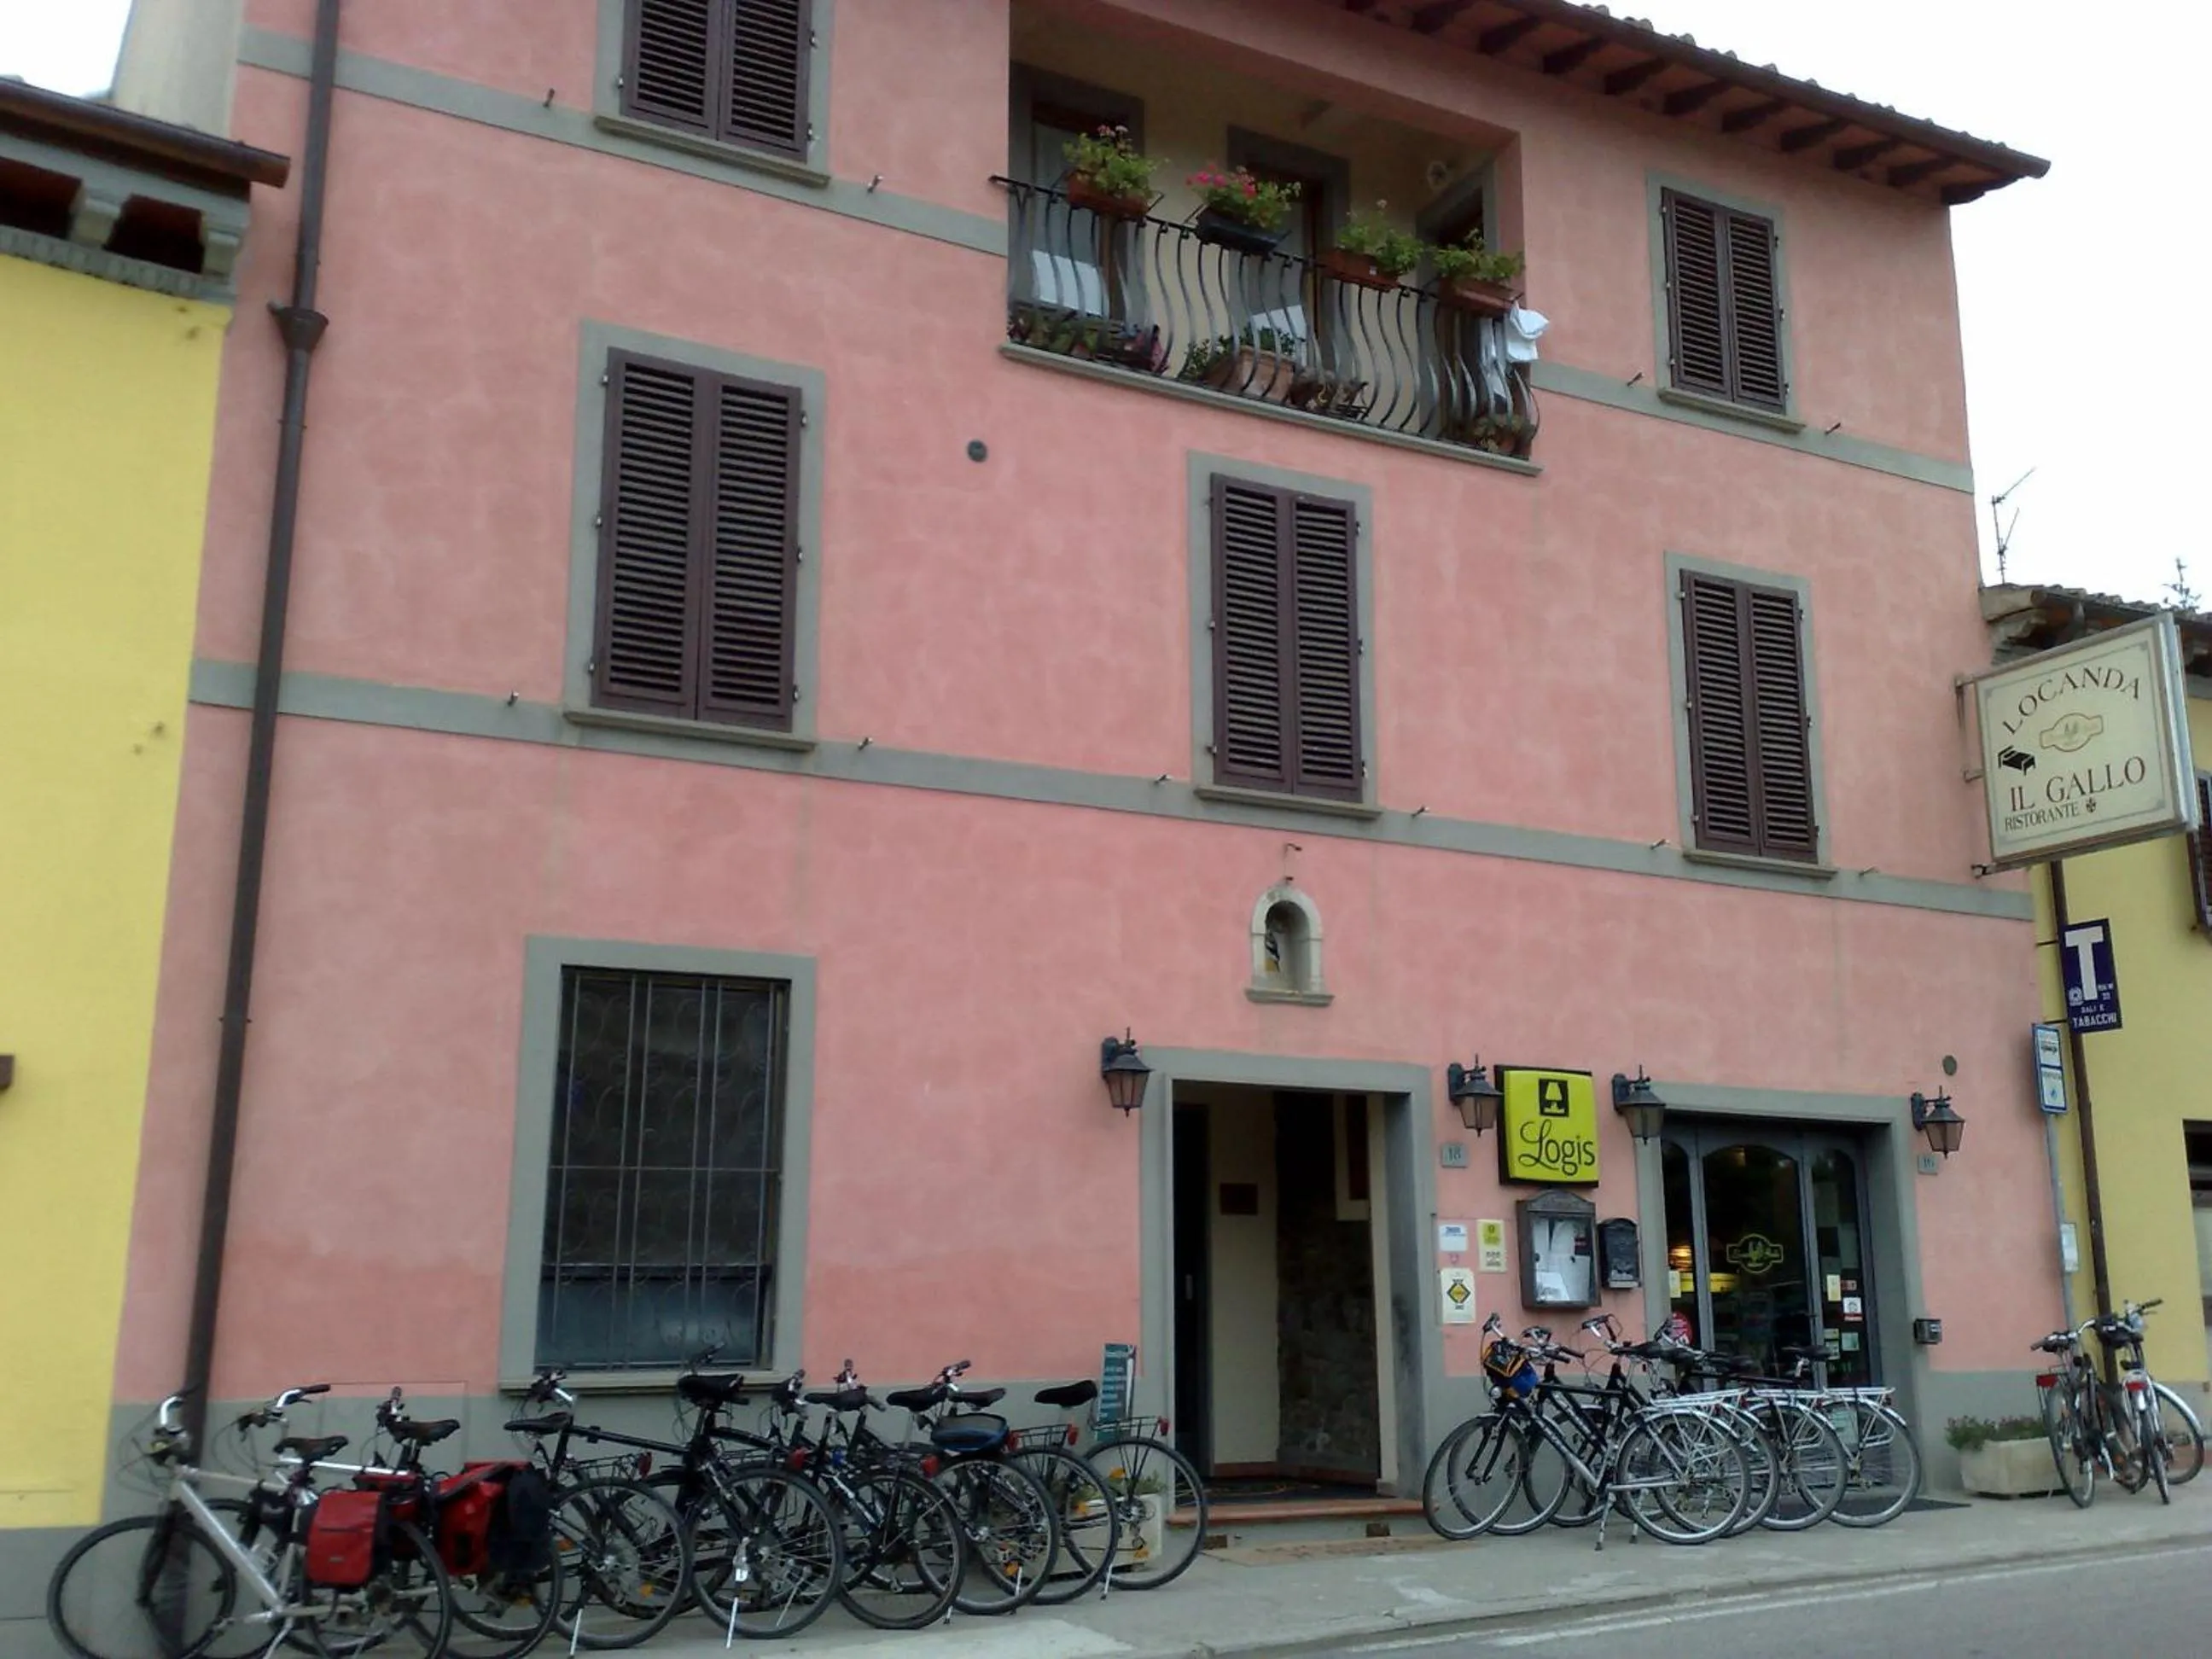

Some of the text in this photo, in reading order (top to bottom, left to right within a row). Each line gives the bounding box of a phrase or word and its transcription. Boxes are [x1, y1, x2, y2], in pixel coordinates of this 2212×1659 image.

[2003, 667, 2139, 735] LOCANDA
[2011, 756, 2145, 812] IL GALLO
[2005, 801, 2079, 831] RISTORANTE
[2064, 926, 2104, 1000] T
[2073, 1012, 2116, 1027] TABACCHI
[1518, 1119, 1596, 1176] Logis
